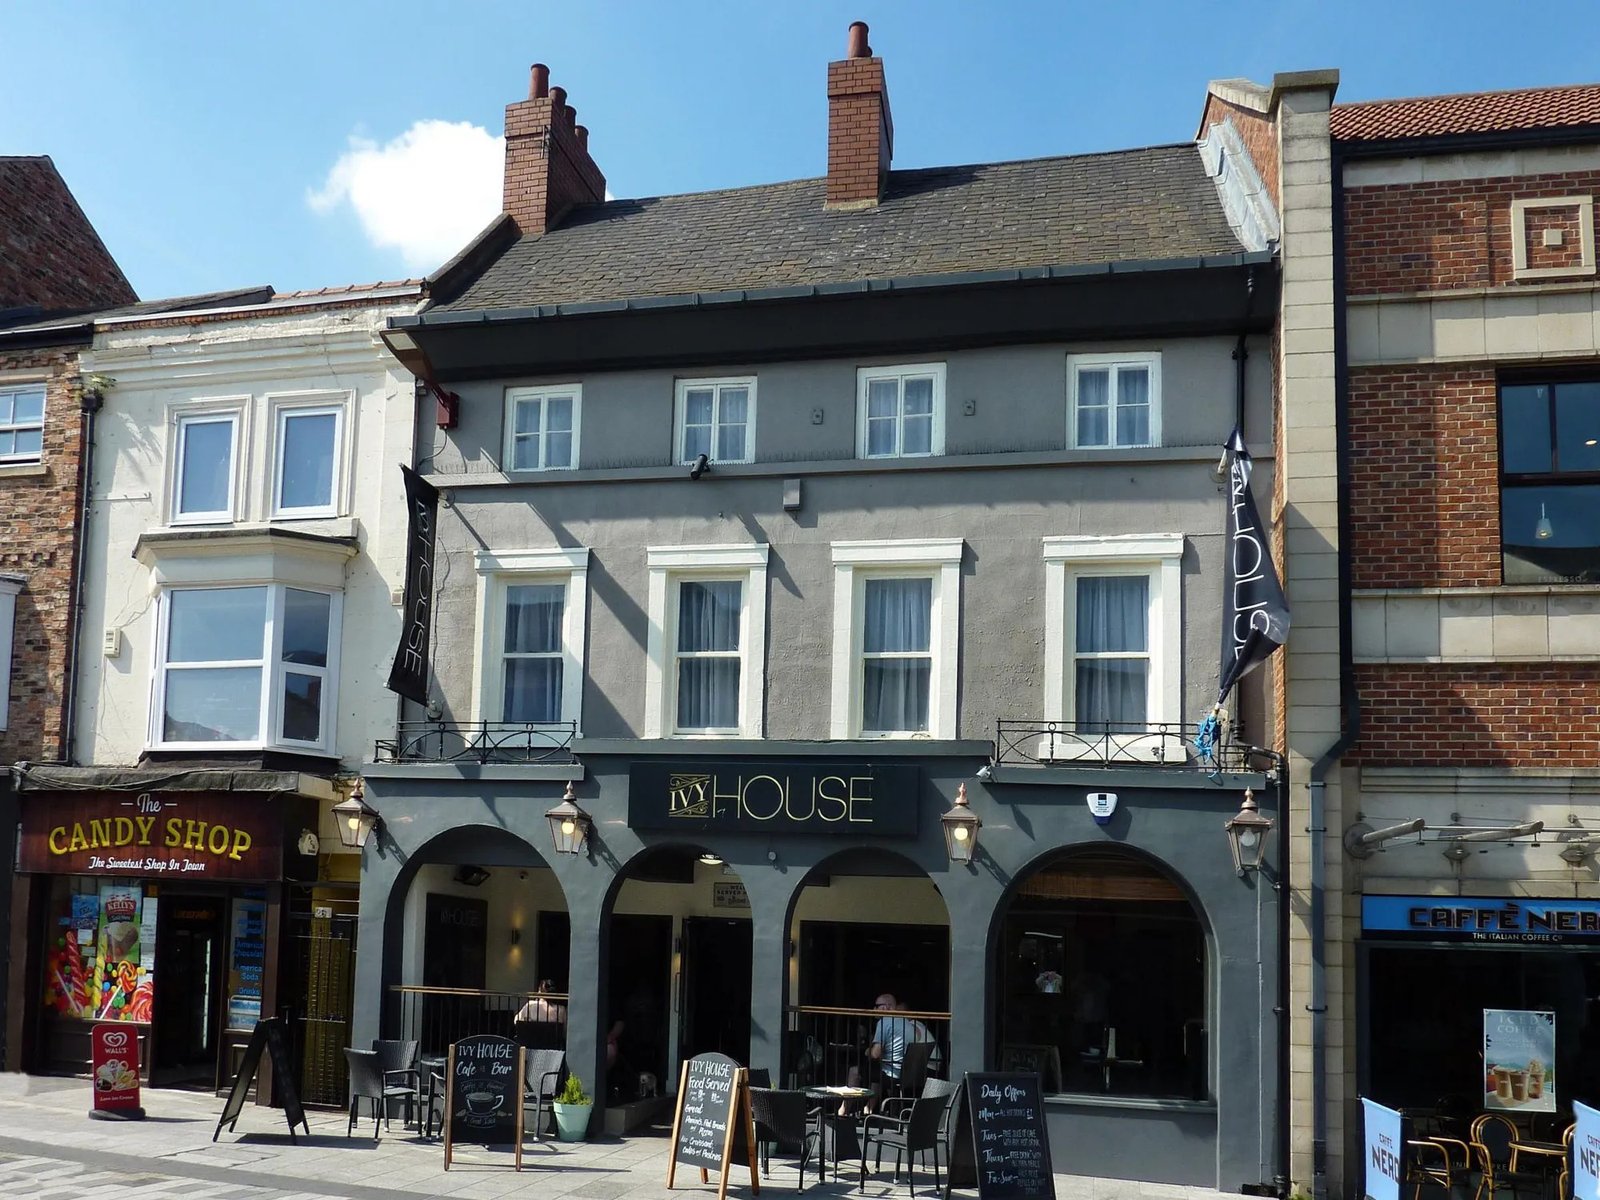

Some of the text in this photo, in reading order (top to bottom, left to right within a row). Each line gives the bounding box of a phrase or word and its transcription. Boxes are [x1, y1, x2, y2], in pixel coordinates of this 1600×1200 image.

[403, 535, 432, 677] HOUSE
[137, 793, 162, 813] The
[669, 774, 874, 823] IVY HOUSE
[48, 816, 252, 862] CANDY SHOP
[88, 856, 205, 873] The Sweetest Shop In Town
[107, 901, 134, 911] KELLY'S
[1408, 902, 1520, 930] CAFFÈ
[1472, 932, 1487, 940] THE
[1488, 932, 1519, 941] ITALIAN
[1521, 933, 1550, 941] COFFEE
[1499, 1014, 1540, 1025] ICED
[1497, 1024, 1545, 1035] COFFEE
[104, 1047, 127, 1055] WALL'S
[458, 1042, 514, 1059] IVY HOUSE
[456, 1061, 477, 1077] Cafe
[491, 1061, 512, 1076] Bar
[691, 1060, 731, 1078] IVY HOUSE
[688, 1075, 732, 1092] Food Served
[980, 1083, 1026, 1105] Daily Offers
[684, 1103, 704, 1114] Great
[701, 1148, 722, 1162] Pastries
